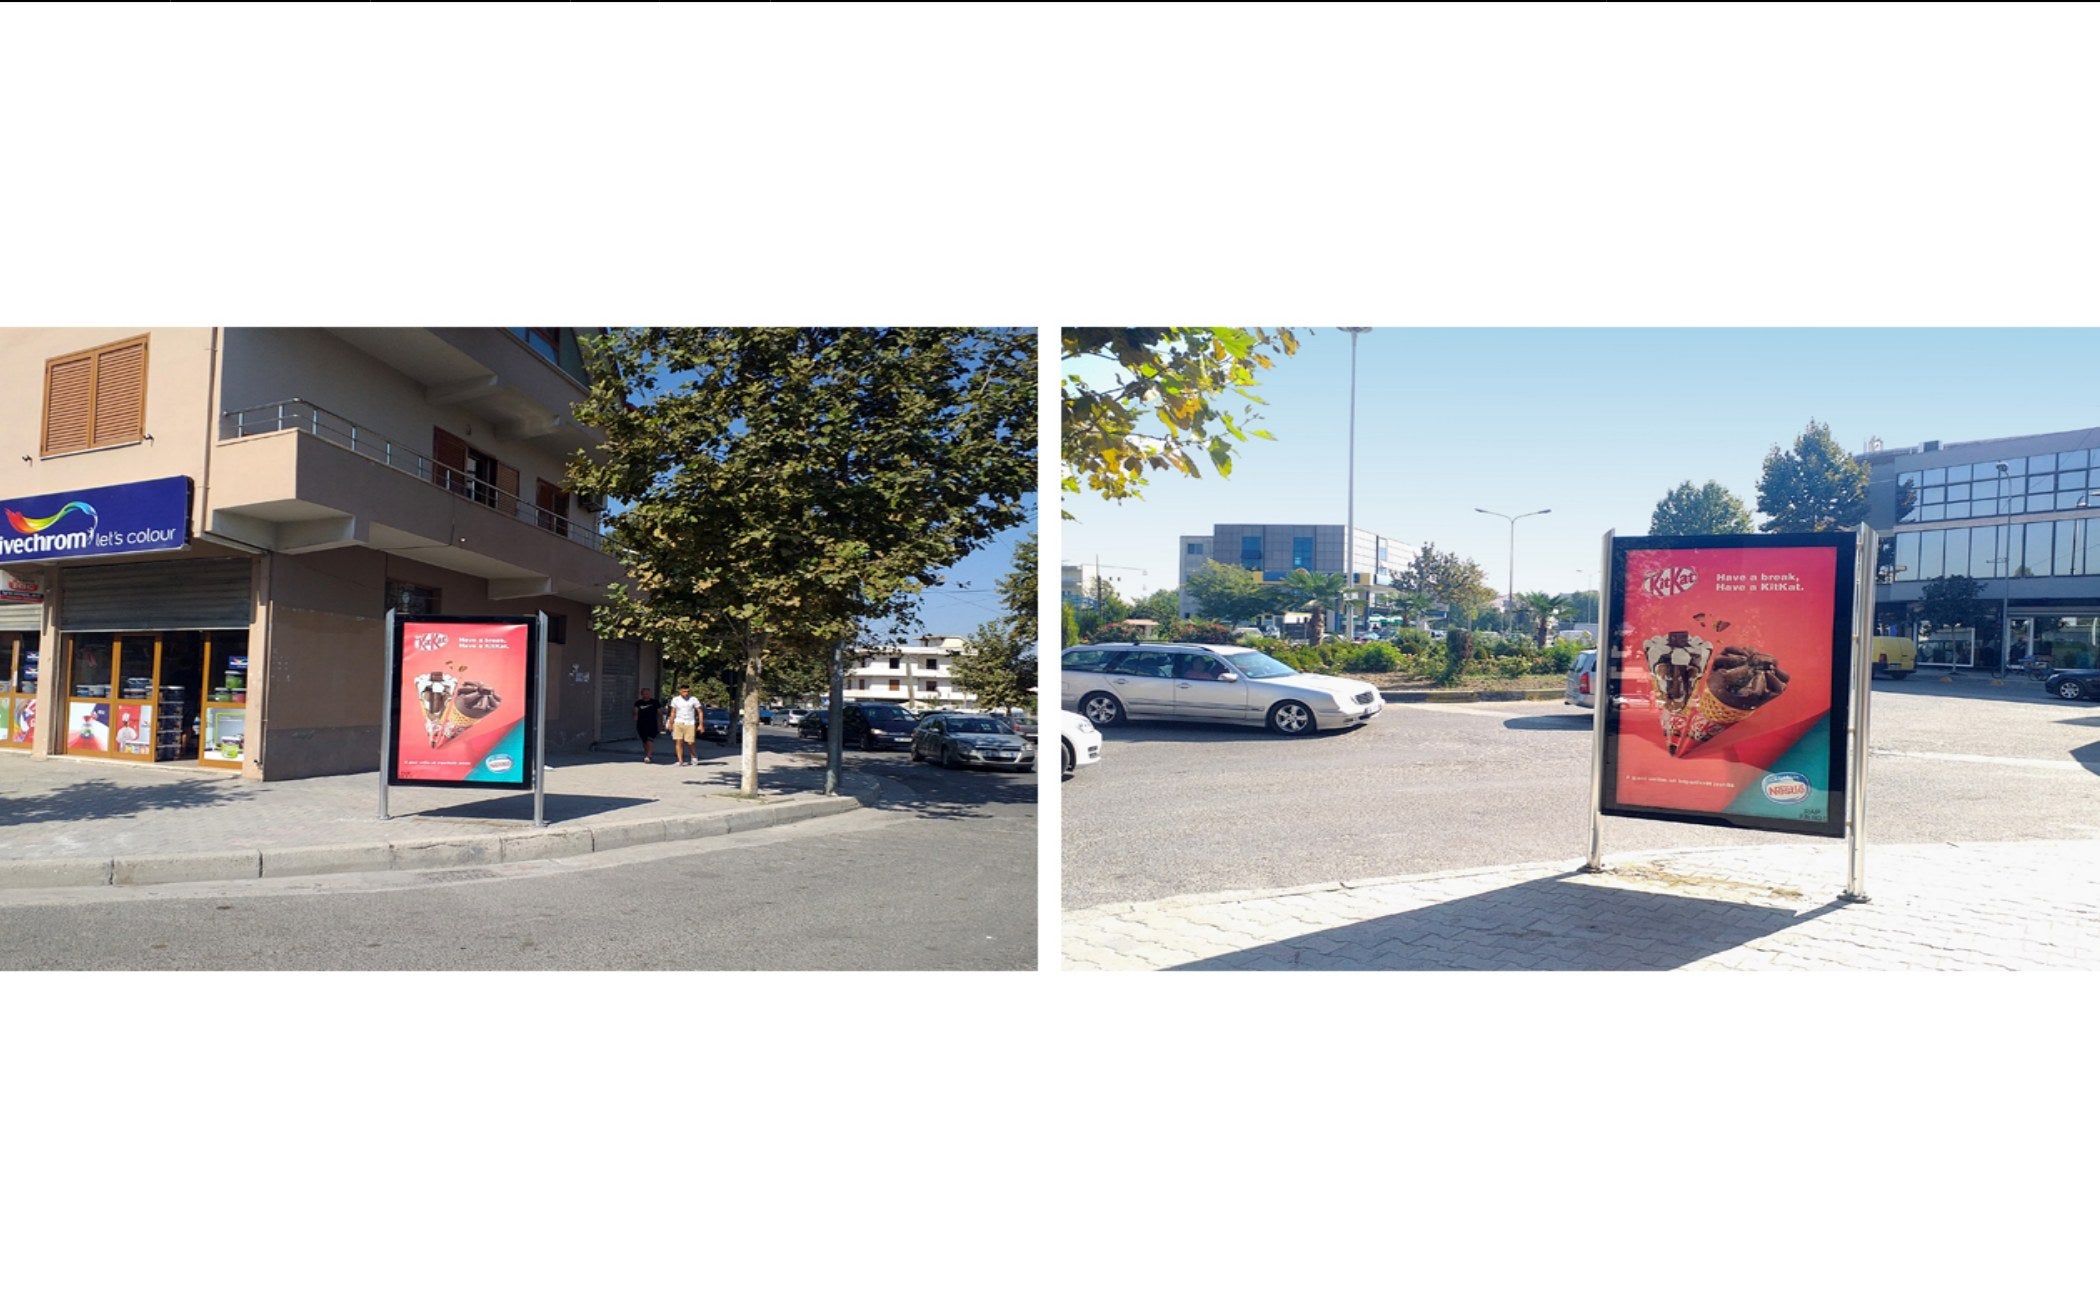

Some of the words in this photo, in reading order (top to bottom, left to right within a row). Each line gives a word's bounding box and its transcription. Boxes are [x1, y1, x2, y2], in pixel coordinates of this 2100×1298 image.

[95, 530, 123, 547] let's
[126, 528, 176, 544] colour
[1647, 567, 1695, 597] KitKat
[1716, 573, 1746, 581] Have
[1761, 573, 1799, 582] break,
[1716, 583, 1746, 591] Have
[1760, 583, 1804, 591] KitKat.
